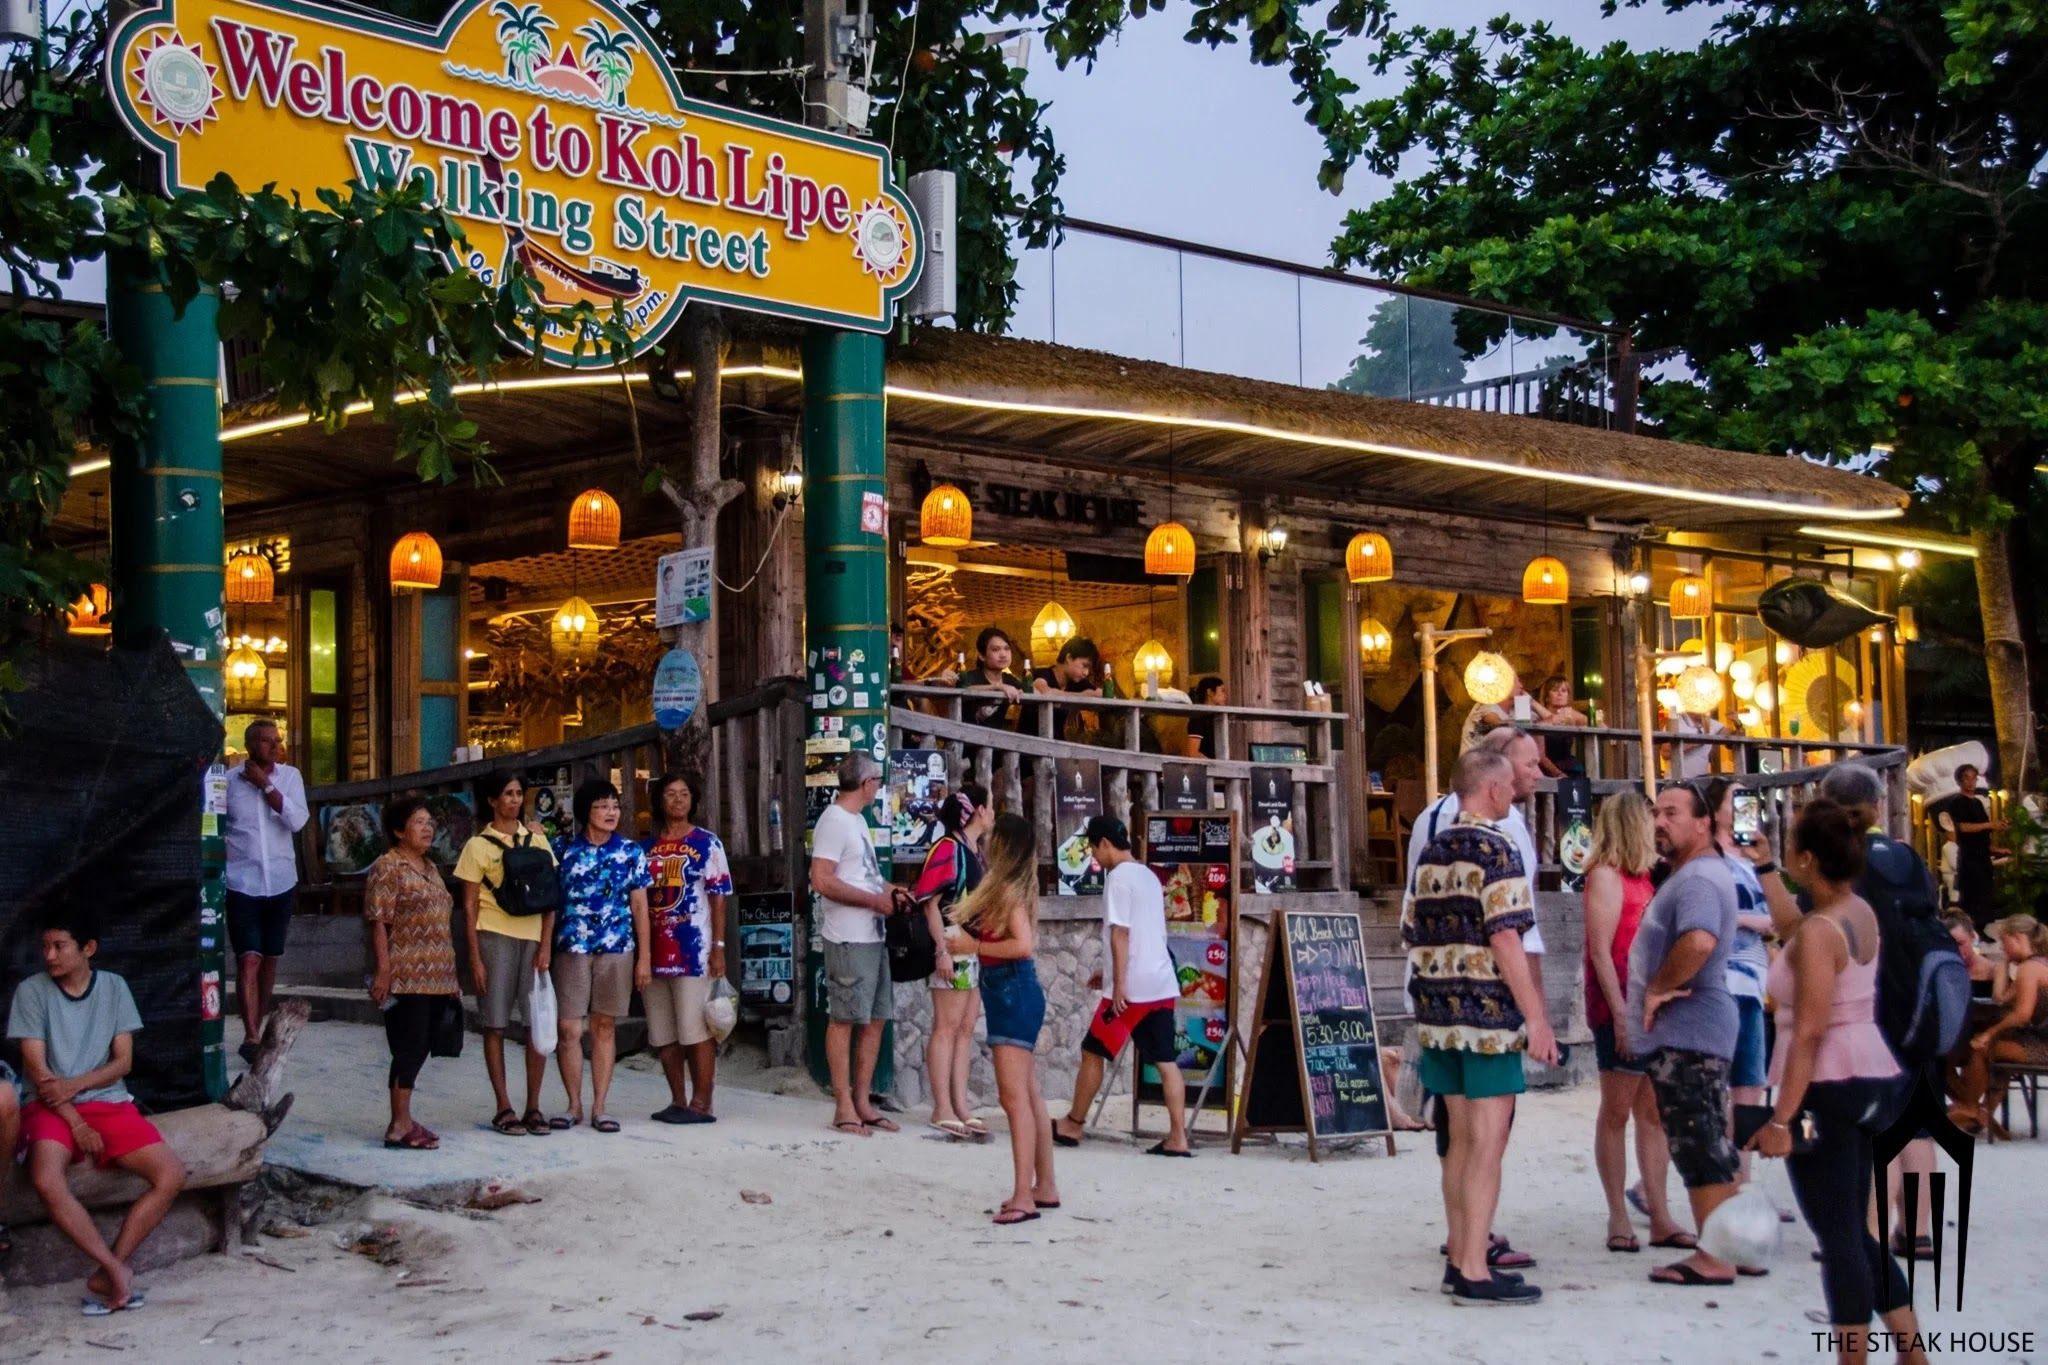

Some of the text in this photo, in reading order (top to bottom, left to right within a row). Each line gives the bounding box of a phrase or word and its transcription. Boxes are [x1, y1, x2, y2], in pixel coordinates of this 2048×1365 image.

[210, 16, 851, 239] Welcome to Koh Lipe
[345, 136, 770, 277] Walking Street
[984, 482, 1064, 520] STEAK
[649, 842, 702, 863] RCELONA
[1208, 873, 1226, 883] 200
[740, 908, 753, 920] The
[1207, 950, 1226, 960] 250
[1206, 1026, 1224, 1037] 250
